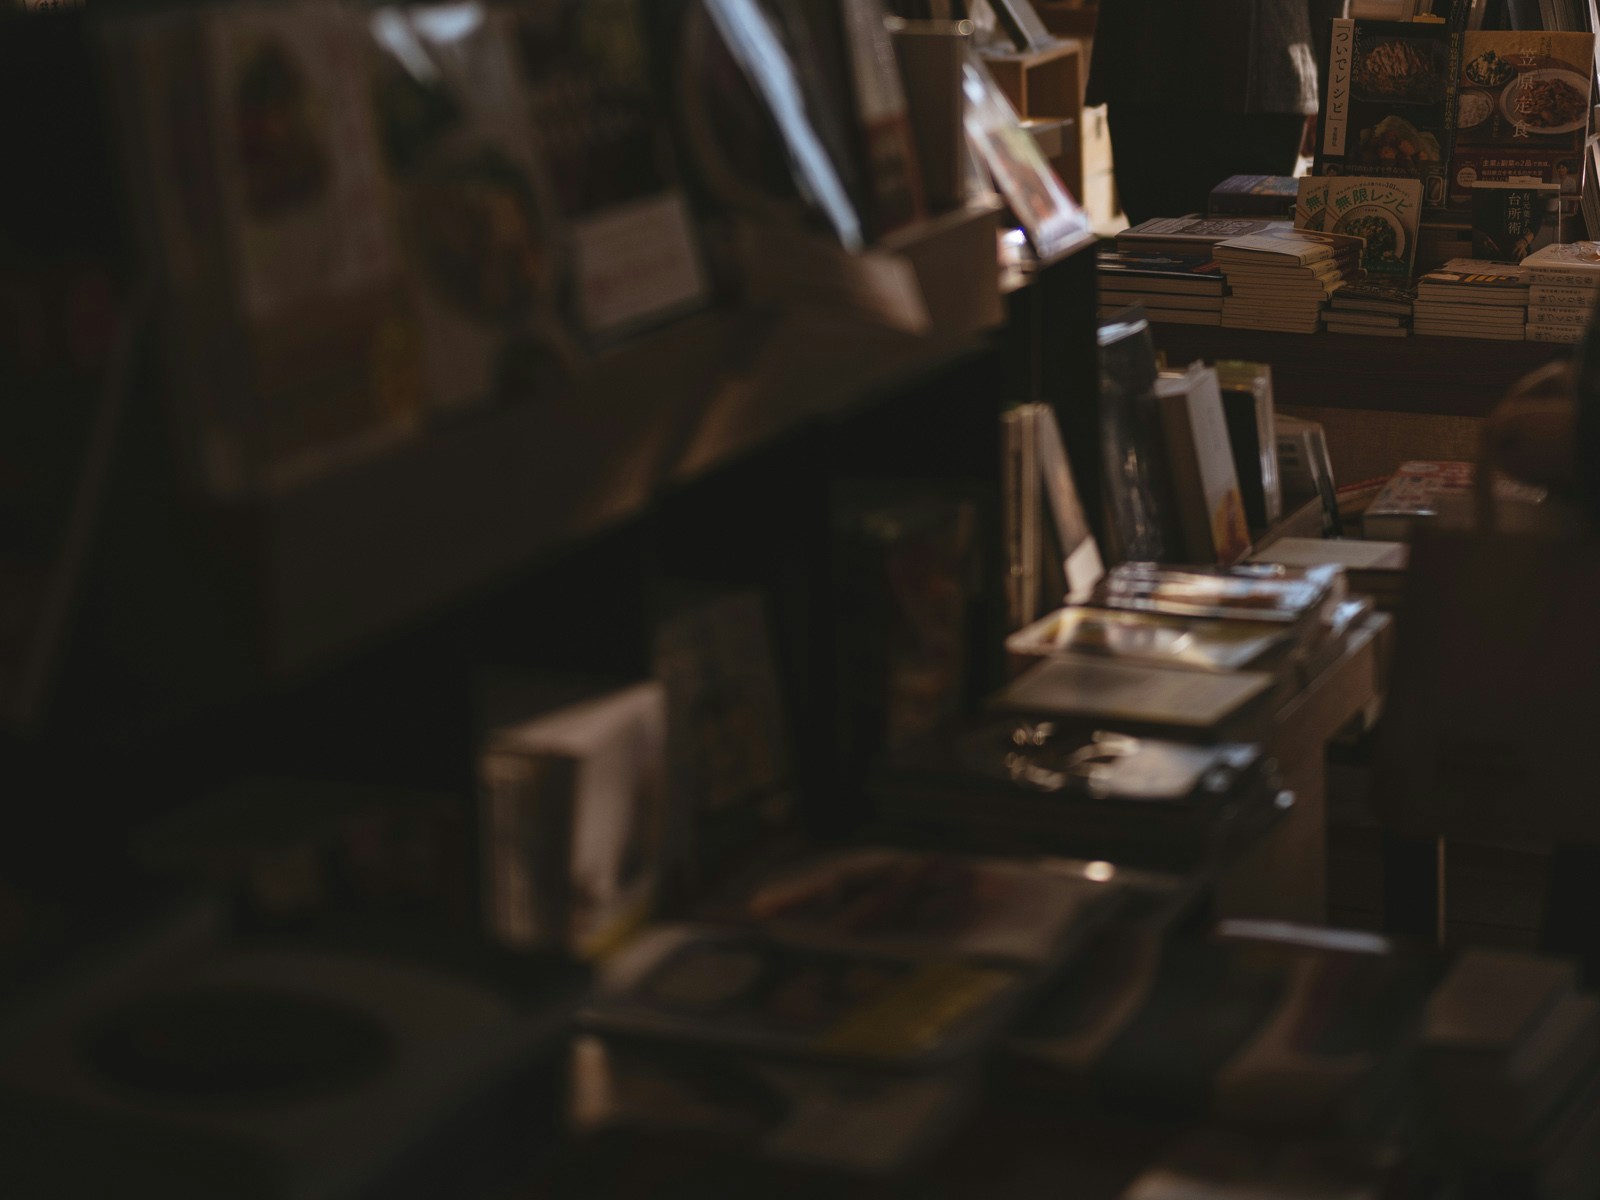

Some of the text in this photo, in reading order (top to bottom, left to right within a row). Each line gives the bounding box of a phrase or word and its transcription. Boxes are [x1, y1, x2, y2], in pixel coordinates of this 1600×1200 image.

[1512, 48, 1537, 138] 笠原定食
[1335, 187, 1409, 214] 無限レシピ
[1507, 192, 1521, 236] 台所術
